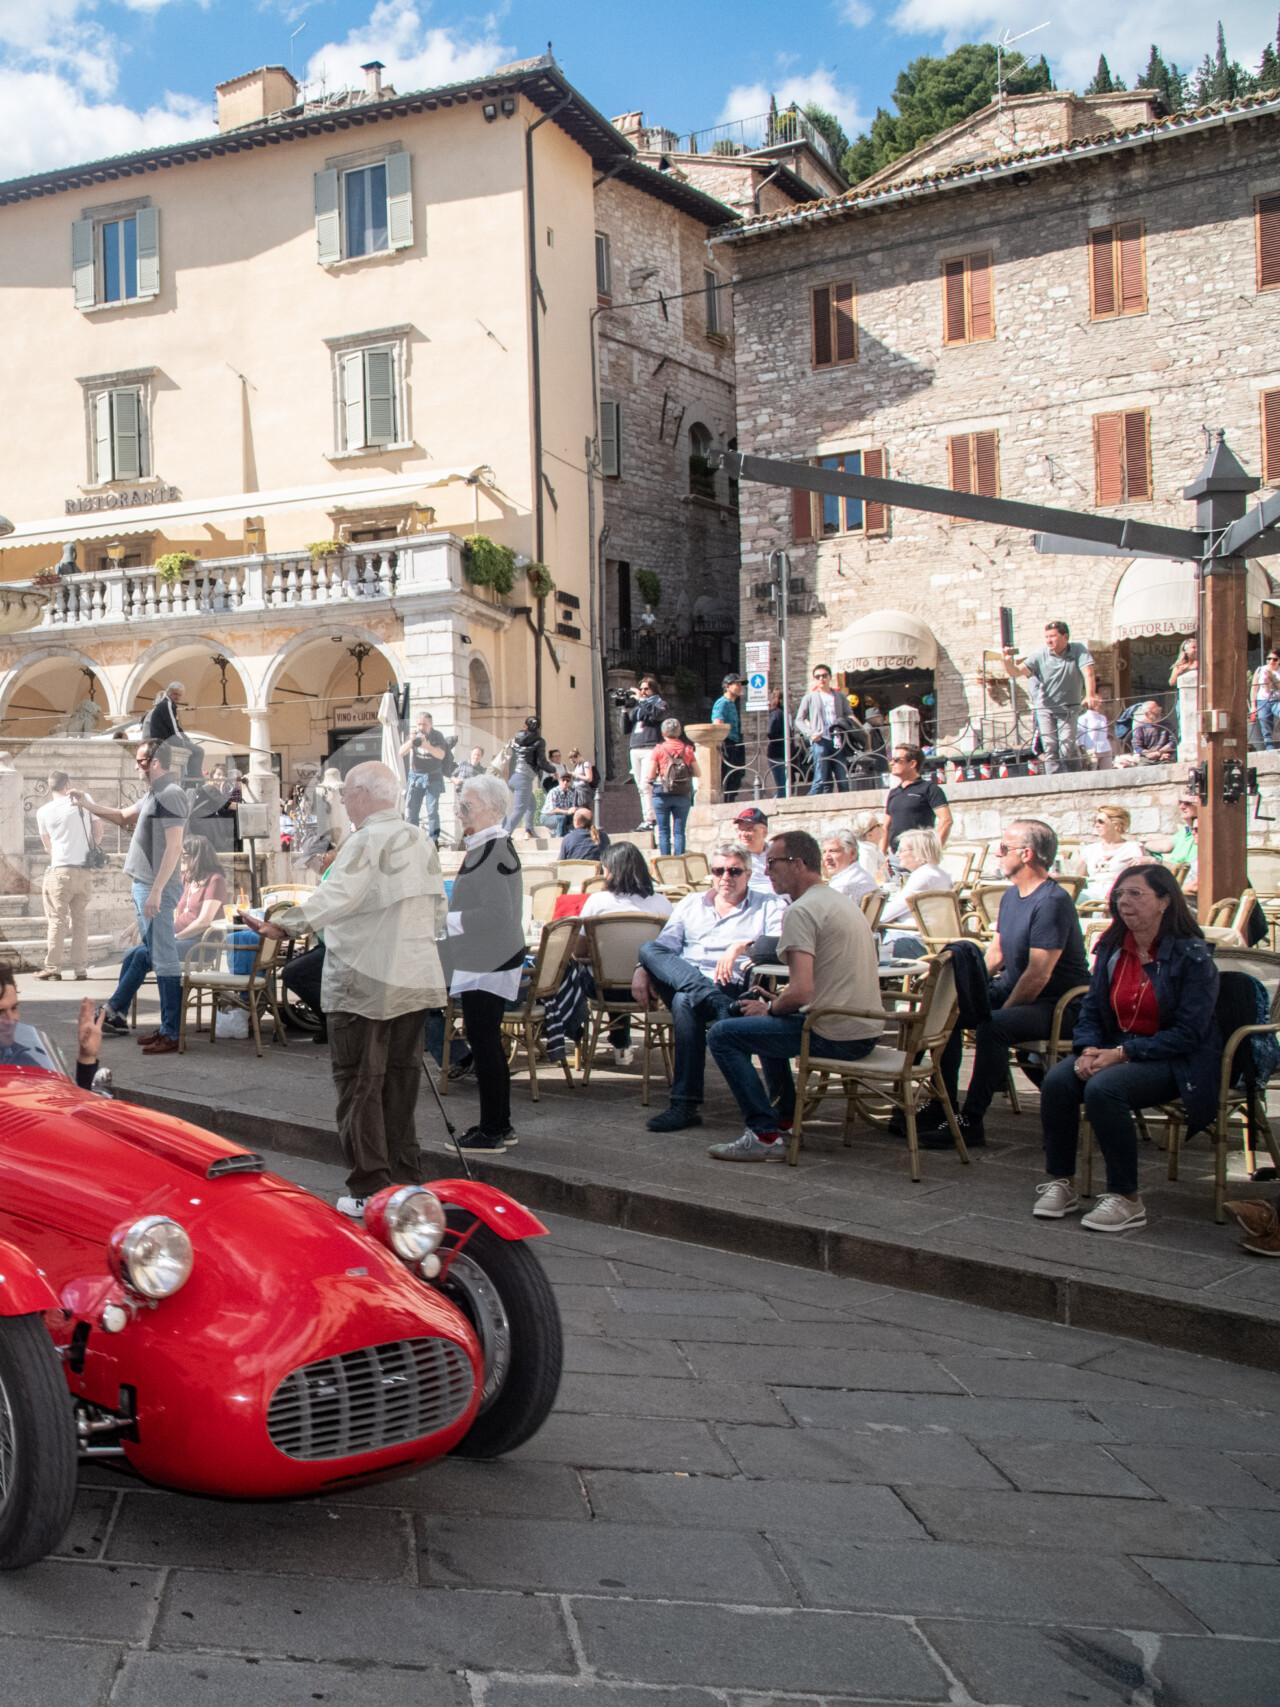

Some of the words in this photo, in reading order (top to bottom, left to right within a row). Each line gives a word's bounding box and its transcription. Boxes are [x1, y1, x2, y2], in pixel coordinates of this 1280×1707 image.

[65, 486, 179, 513] RISTORANTE
[1118, 622, 1176, 638] TRATTORIA
[336, 711, 352, 722] VINO
